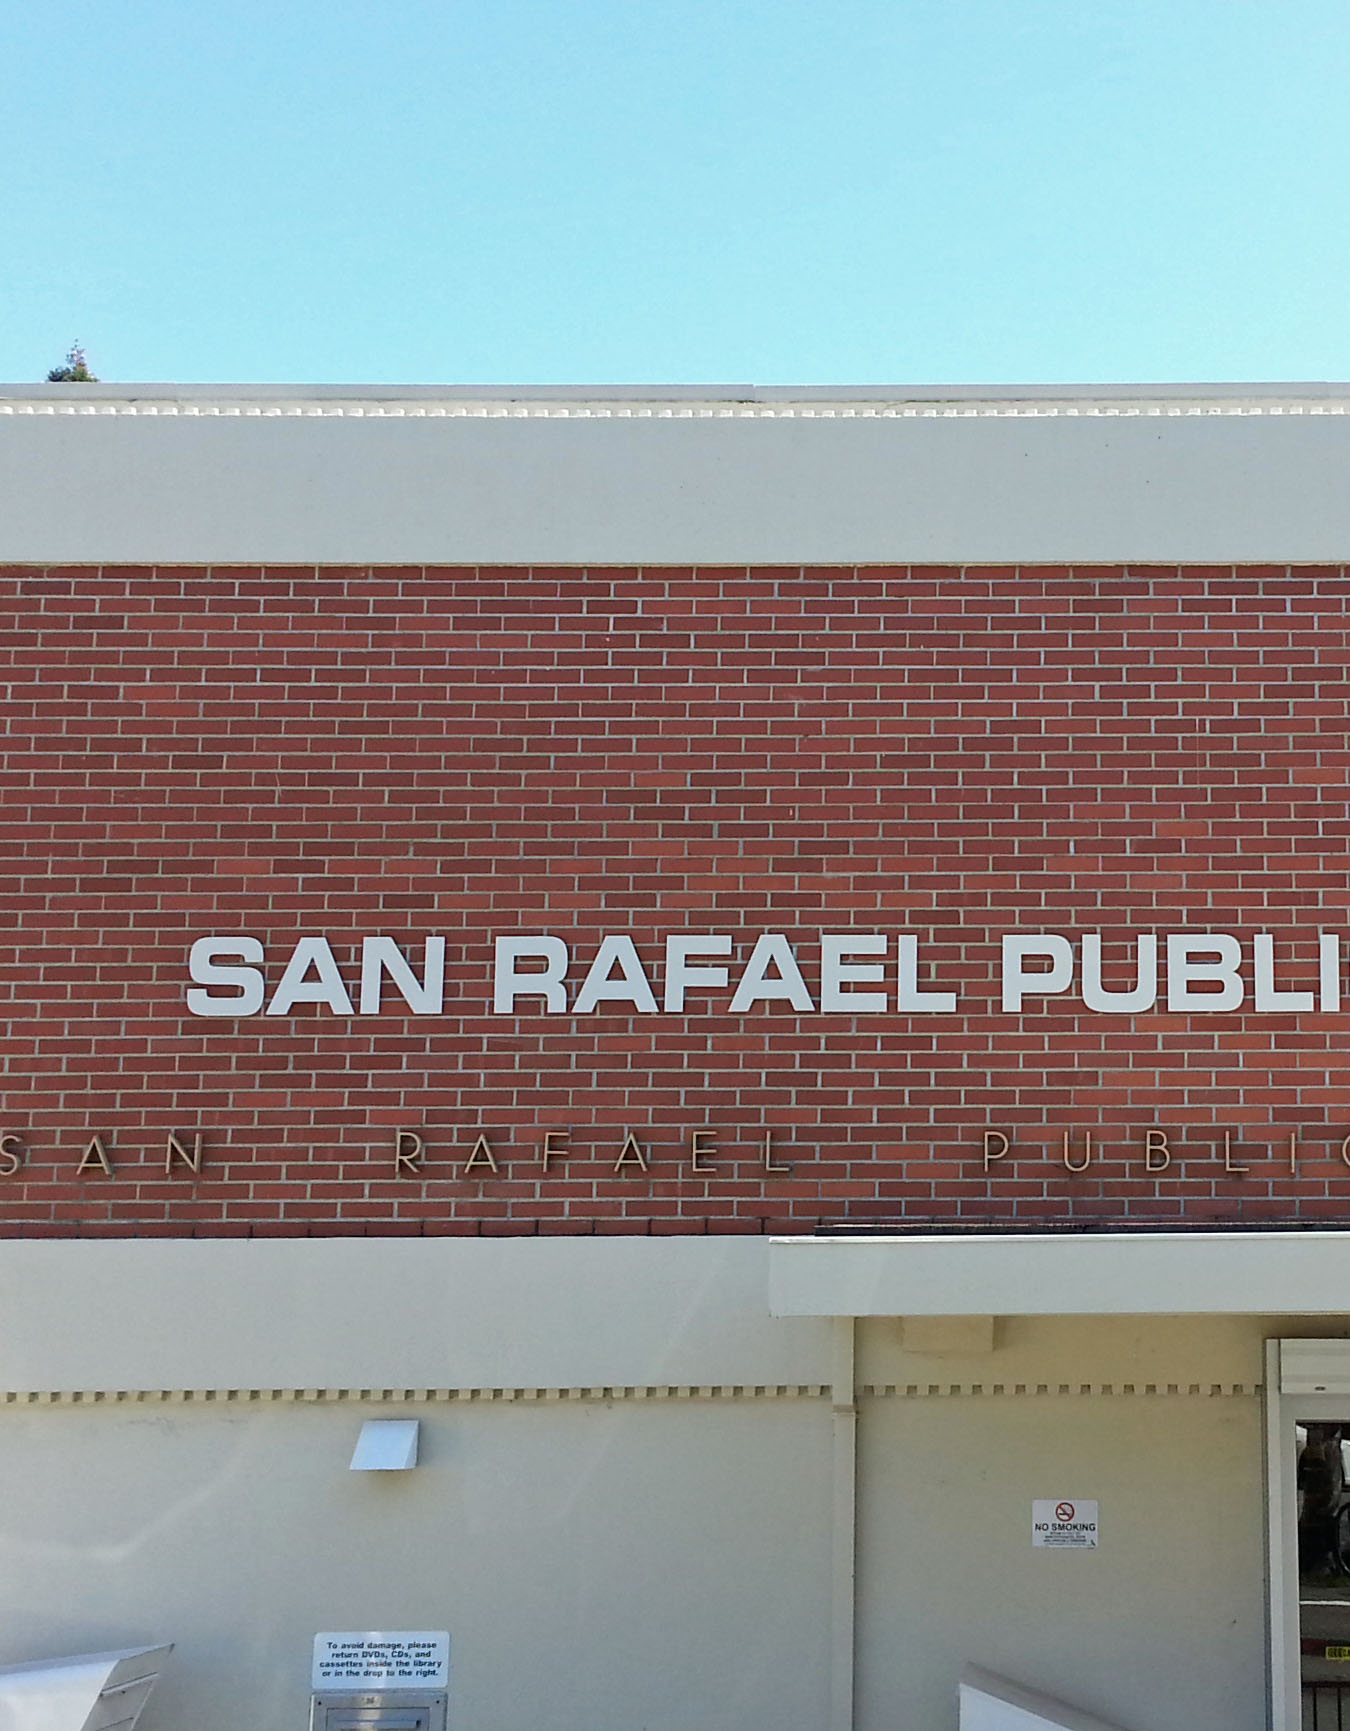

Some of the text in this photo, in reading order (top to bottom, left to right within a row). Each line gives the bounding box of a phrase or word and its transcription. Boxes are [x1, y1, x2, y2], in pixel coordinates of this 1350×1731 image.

[187, 935, 446, 1017] SAN
[493, 934, 957, 1015] RAFAEL
[0, 1133, 203, 1176] SAN
[396, 1131, 793, 1175] RAFAEL
[1035, 1523, 1096, 1531] NO SMOKING
[341, 1641, 364, 1649] avoid
[367, 1642, 405, 1650] damage,
[362, 1651, 388, 1659] DVDs,
[391, 1651, 412, 1659] CDs,
[320, 1660, 363, 1668] cassettes
[413, 1660, 442, 1668] library
[363, 1670, 383, 1678] drop
[416, 1669, 439, 1677] right.
